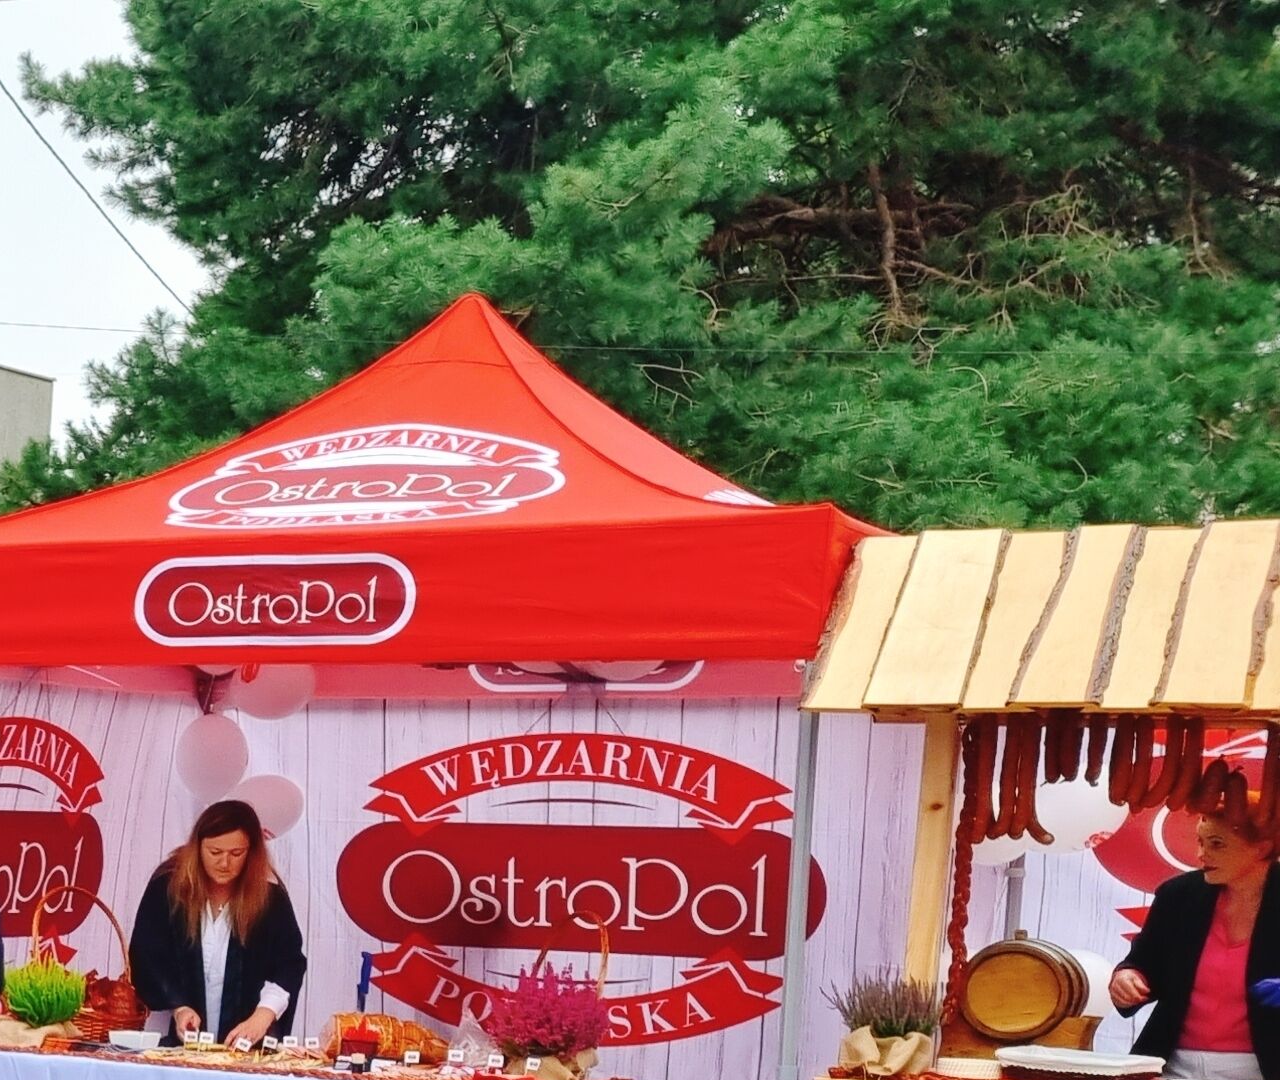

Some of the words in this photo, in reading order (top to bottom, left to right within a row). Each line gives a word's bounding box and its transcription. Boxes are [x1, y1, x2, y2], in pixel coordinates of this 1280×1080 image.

[214, 472, 518, 505] OstroPol
[167, 575, 378, 626] OstroPol
[419, 738, 722, 805] WĘDZARNIA
[381, 849, 769, 938] OstroPol
[425, 973, 715, 1041] POSKA
